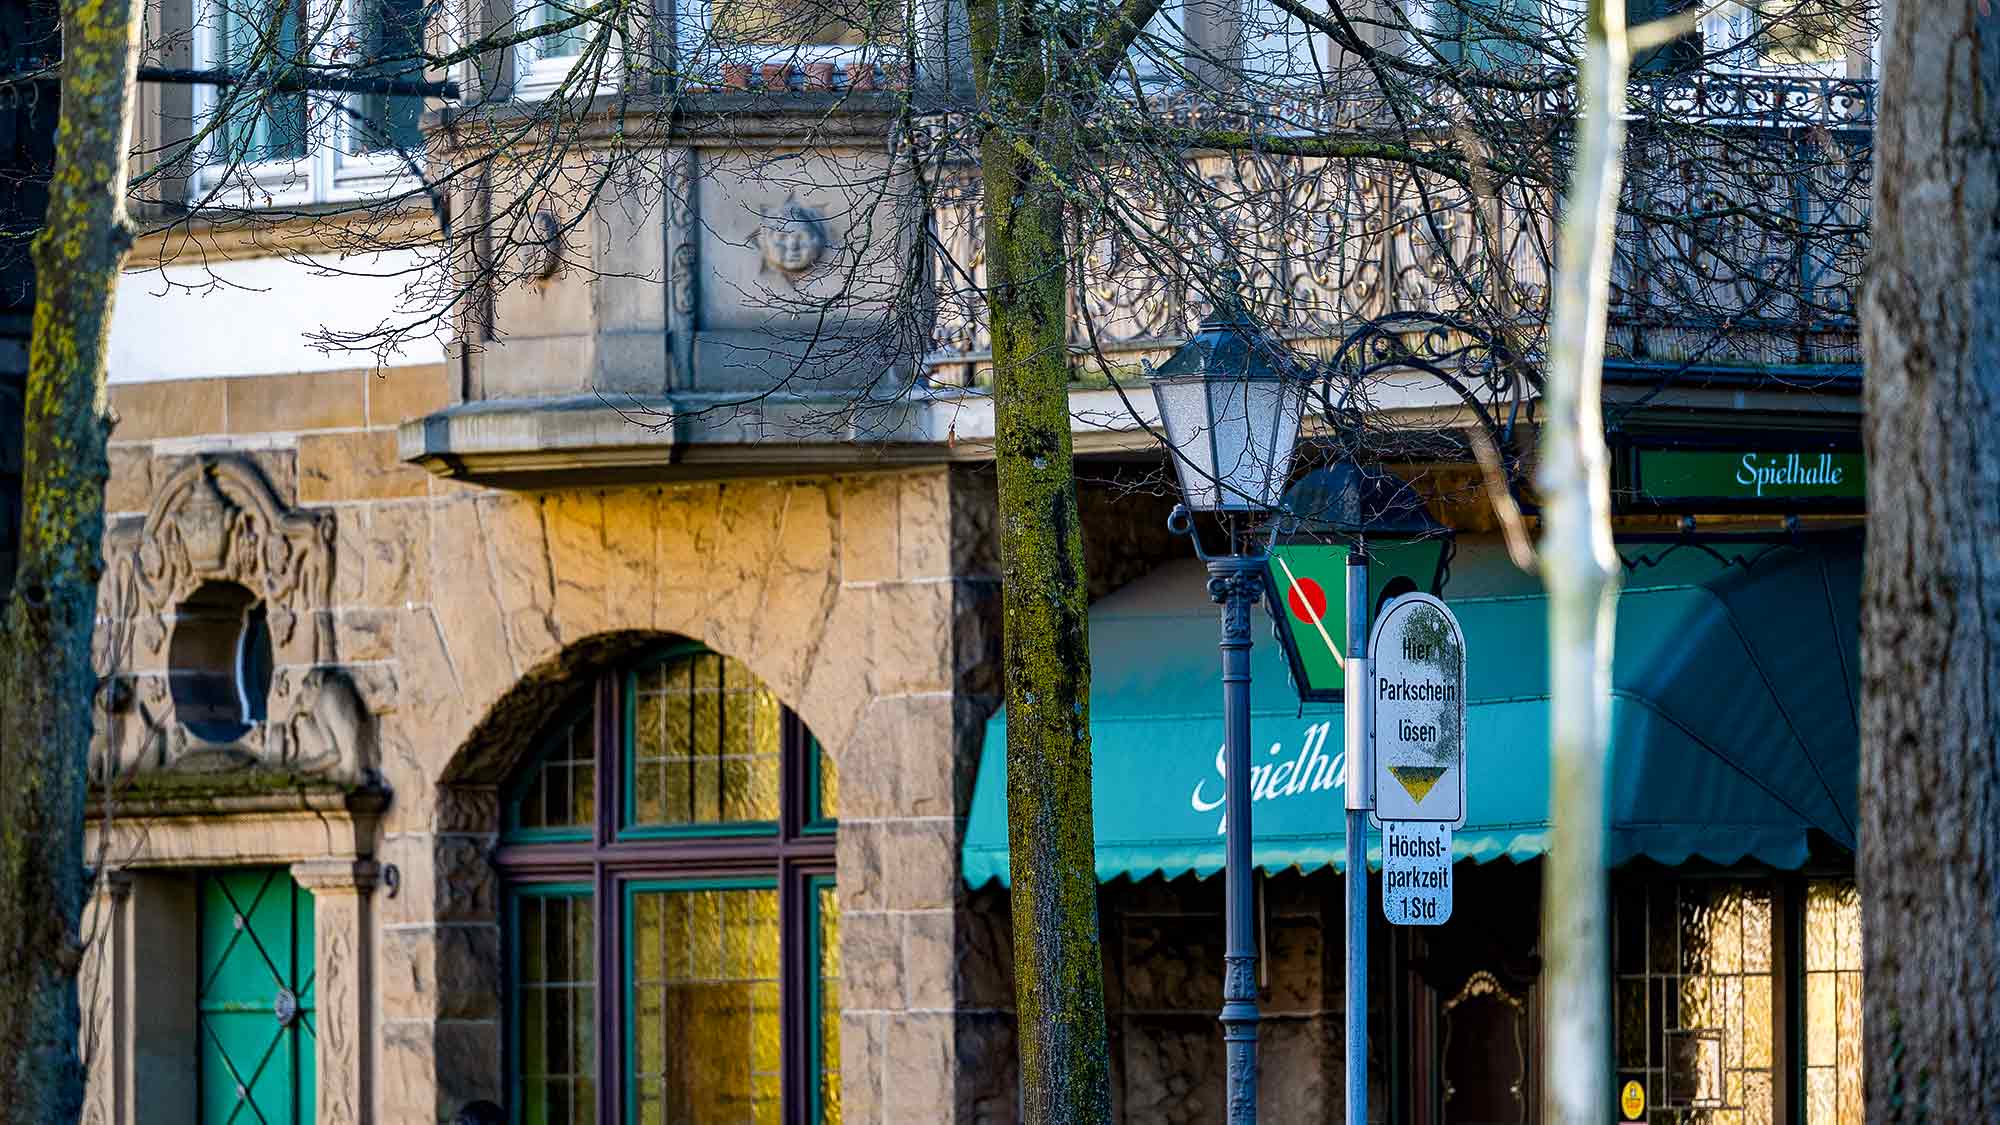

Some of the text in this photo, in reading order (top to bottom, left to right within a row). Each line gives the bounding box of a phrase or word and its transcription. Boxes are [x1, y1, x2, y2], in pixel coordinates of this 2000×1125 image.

[1736, 452, 1842, 497] Spielhalle
[1402, 636, 1432, 660] Hier
[1380, 677, 1455, 701] Parkschein
[1398, 719, 1437, 742] lösen
[1389, 834, 1447, 858] Höchst-
[384, 863, 400, 900] 9
[1388, 865, 1449, 894] parkzeit
[1400, 896, 1436, 919] 1 Std
